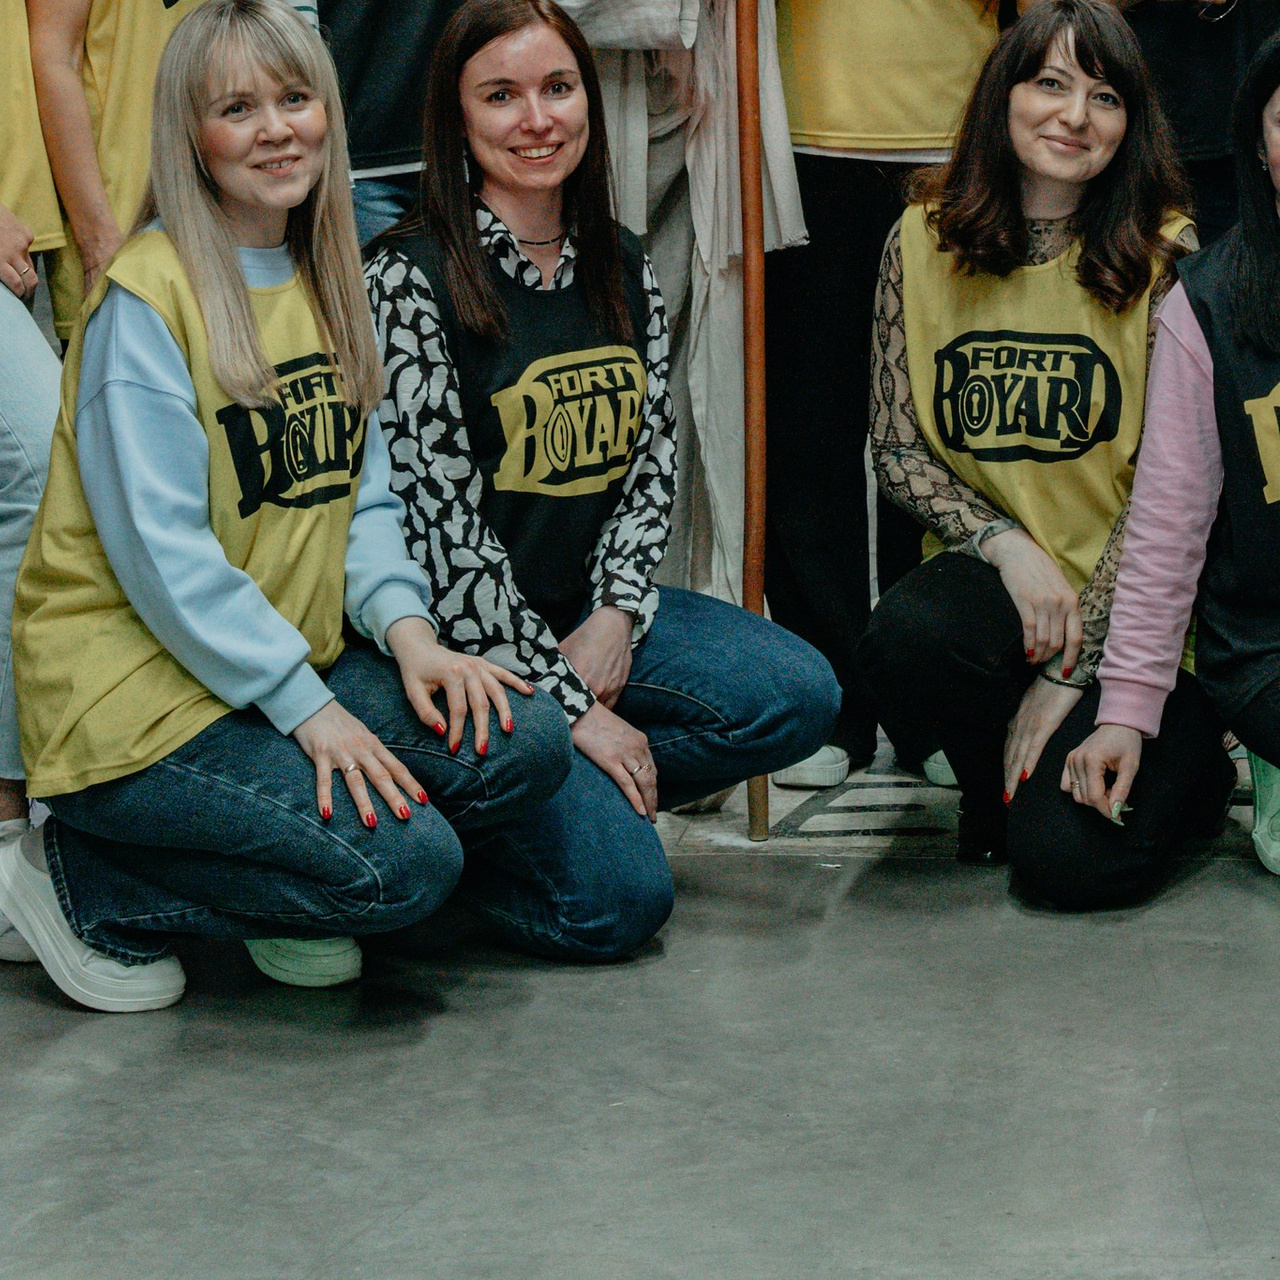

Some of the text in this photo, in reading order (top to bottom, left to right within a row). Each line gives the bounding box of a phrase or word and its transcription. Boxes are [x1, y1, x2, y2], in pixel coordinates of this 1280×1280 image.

[970, 346, 1070, 372] FORT
[547, 362, 627, 401] FORT
[933, 348, 1122, 454] BOYARD
